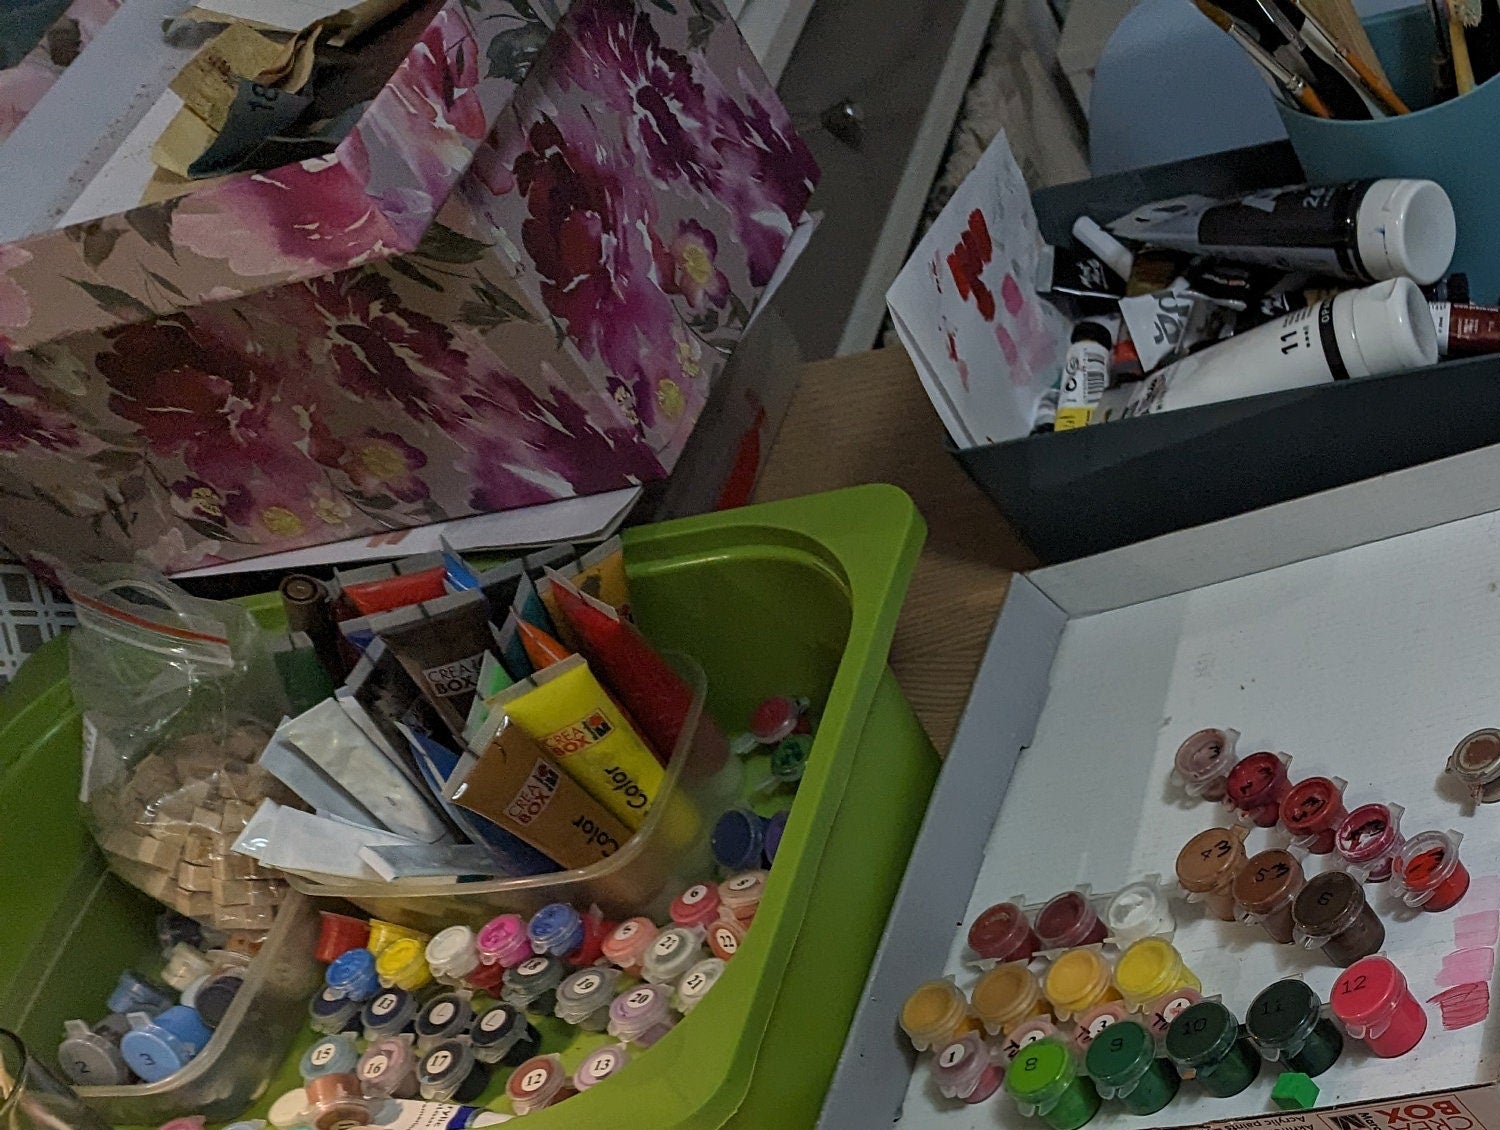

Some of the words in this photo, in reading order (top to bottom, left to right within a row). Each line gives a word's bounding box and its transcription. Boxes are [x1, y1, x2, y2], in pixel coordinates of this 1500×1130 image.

[1280, 331, 1298, 355] 11
[428, 664, 473, 683] CREA
[552, 739, 592, 757] BOX
[604, 766, 648, 809] Color
[508, 784, 540, 818] CREA
[518, 791, 550, 824] BOX
[572, 815, 620, 858] Color
[720, 934, 736, 948] 22
[577, 977, 594, 991] 19
[687, 974, 704, 990] 21
[1342, 975, 1366, 994] 12
[377, 998, 393, 1010] 13
[631, 992, 650, 1004] 20
[1182, 1018, 1207, 1036] 10
[1110, 1038, 1123, 1052] 9
[139, 1053, 156, 1066] 3
[314, 1048, 332, 1060] 15
[431, 1055, 447, 1067] 17
[74, 1060, 91, 1074] 2
[366, 1062, 382, 1074] 16
[594, 1058, 610, 1071] 13
[1025, 1058, 1037, 1071] 8
[527, 1073, 542, 1085] 12
[1374, 1100, 1462, 1125] BOX
[1264, 1115, 1306, 1128] Acrylic
